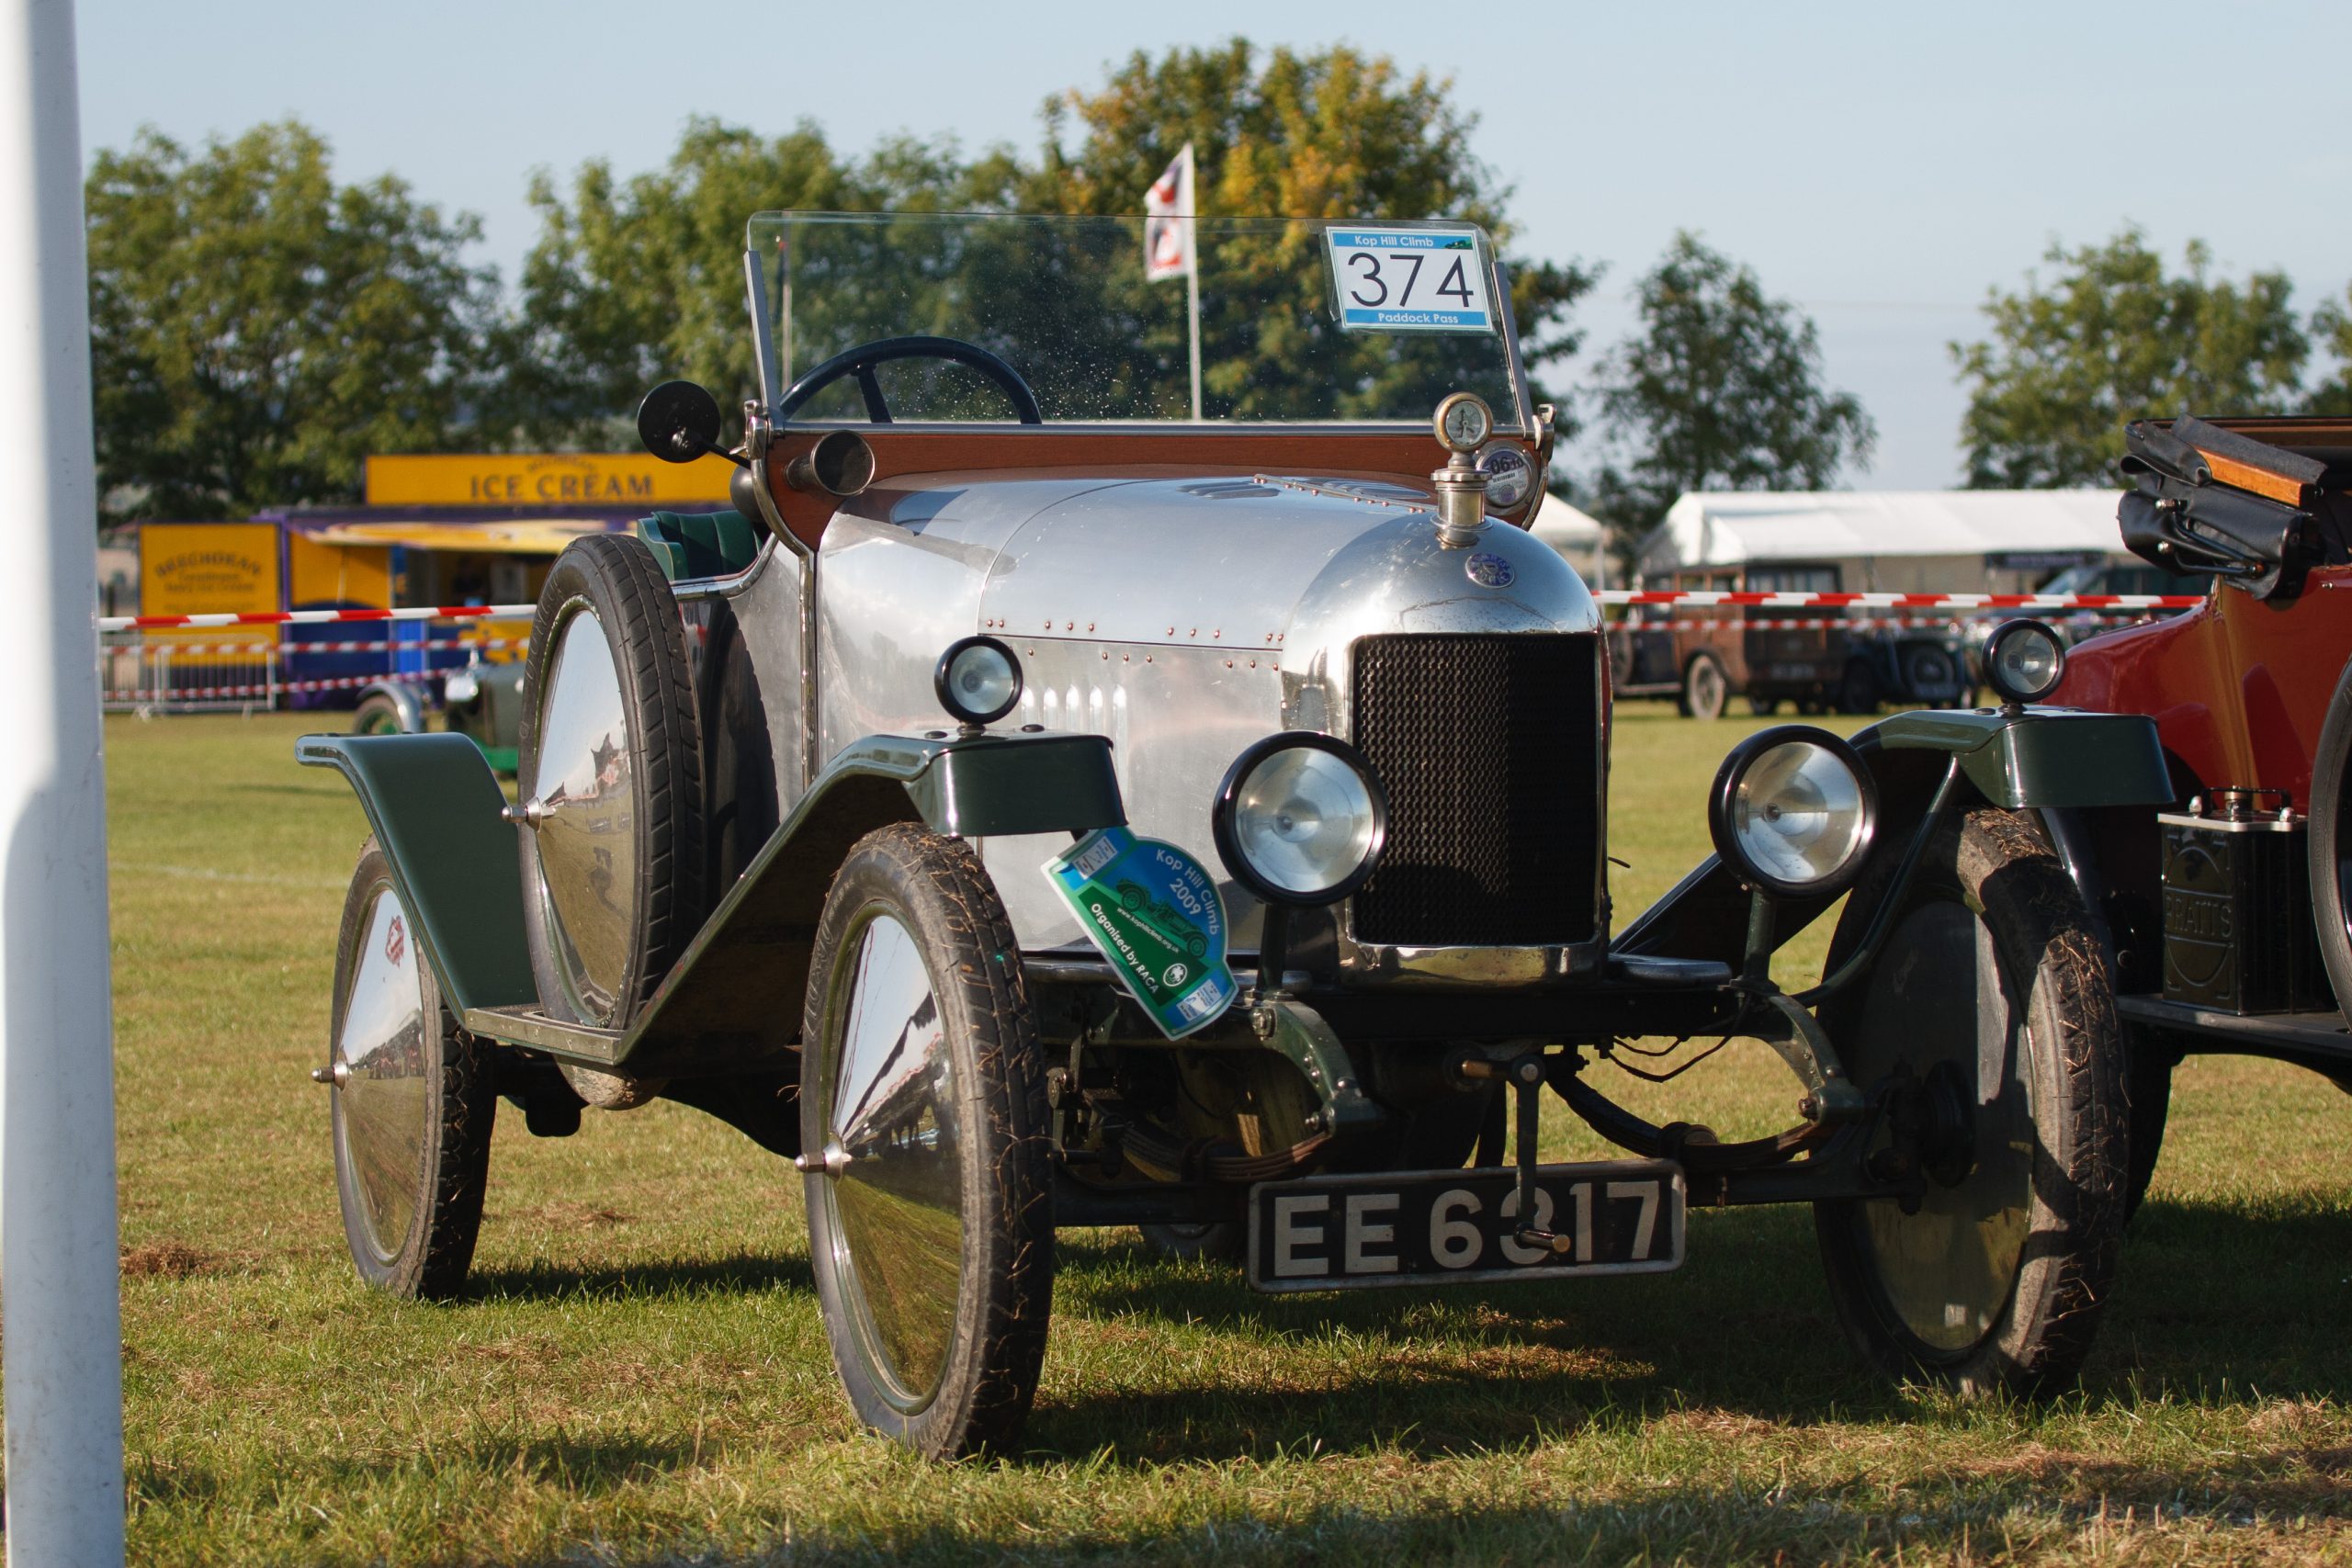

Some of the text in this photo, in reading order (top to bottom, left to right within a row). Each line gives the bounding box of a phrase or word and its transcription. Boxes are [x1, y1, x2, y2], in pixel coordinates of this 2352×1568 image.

[1354, 235, 1434, 247] Kop Hill Climb
[1348, 252, 1474, 308] 374
[1378, 312, 1459, 323] Paddock Pass
[470, 474, 653, 500] ICE CREAM
[1156, 849, 1220, 935] Kop Hill Climb
[1169, 877, 1202, 915] 2009
[1091, 903, 1132, 953] Organised
[1125, 951, 1139, 966] by
[1136, 964, 1159, 994] RACA
[1116, 908, 1180, 954] www.kophillclimb.org.uk
[1273, 1179, 1660, 1277] EE 6317
